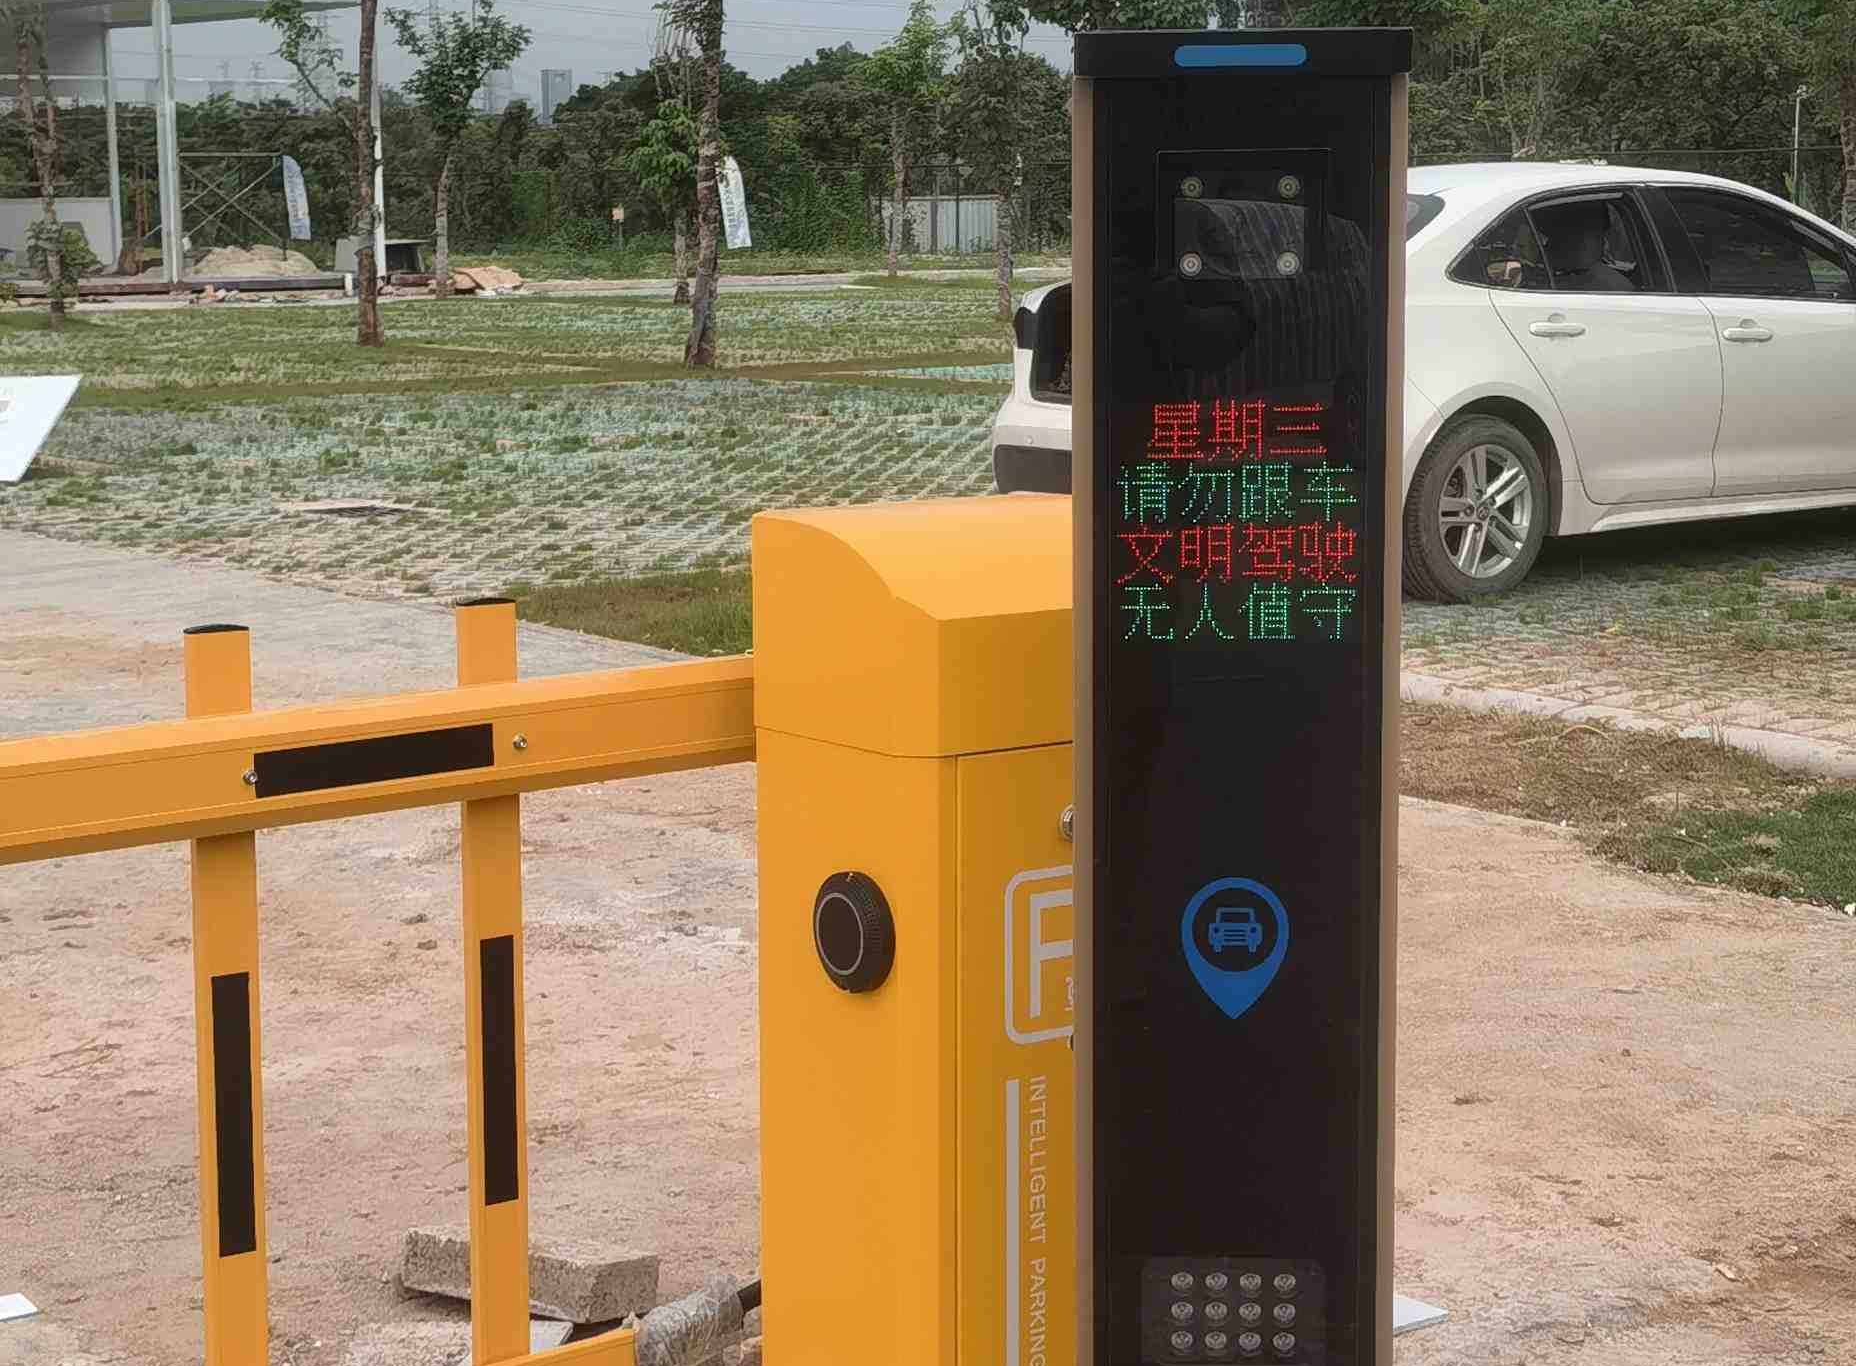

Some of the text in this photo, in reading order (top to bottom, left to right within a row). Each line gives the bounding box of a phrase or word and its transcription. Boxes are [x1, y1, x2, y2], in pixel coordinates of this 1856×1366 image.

[1147, 399, 1328, 461] 星期三
[1116, 461, 1359, 523] 请勿跟车
[1114, 523, 1357, 584] 文明驾驶
[1119, 583, 1357, 641] 无人值守
[1029, 1075, 1047, 1243] INTELLIGENT
